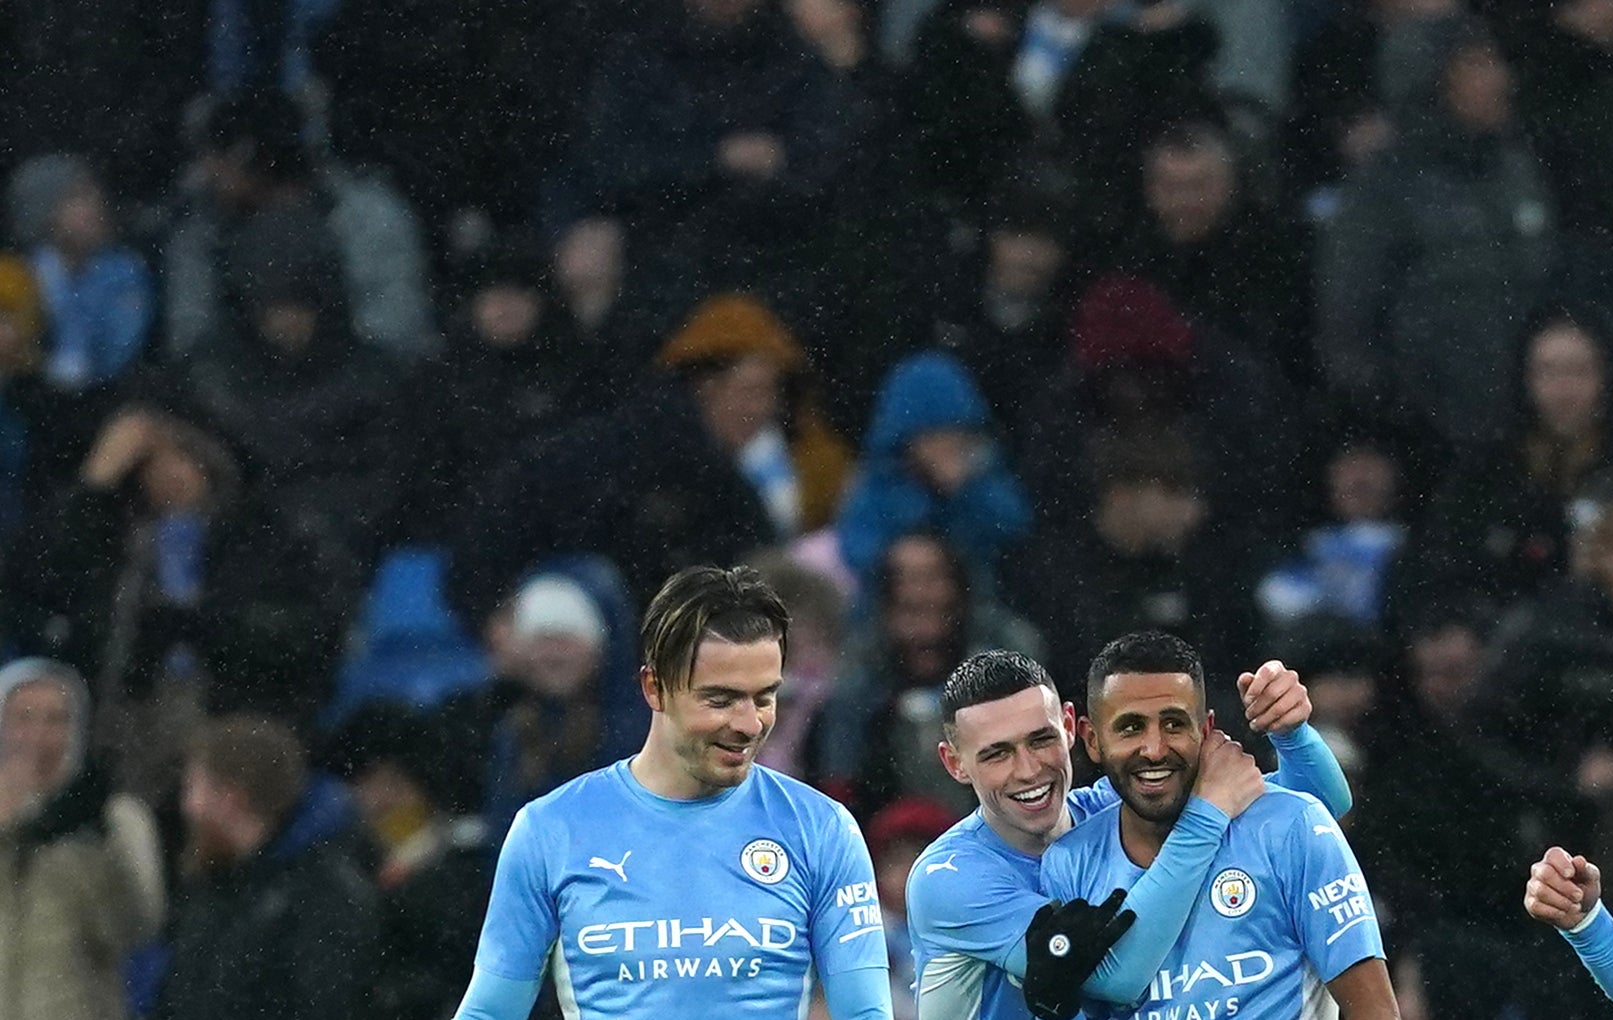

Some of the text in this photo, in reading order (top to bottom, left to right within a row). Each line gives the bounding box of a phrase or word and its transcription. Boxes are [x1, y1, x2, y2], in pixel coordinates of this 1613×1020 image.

[836, 881, 880, 908] NEX
[849, 903, 883, 926] TIR
[1328, 895, 1373, 925] TIR
[577, 917, 797, 955] ETIHAD
[617, 957, 763, 982] AIRWAYS
[1150, 950, 1273, 1001] IHAD
